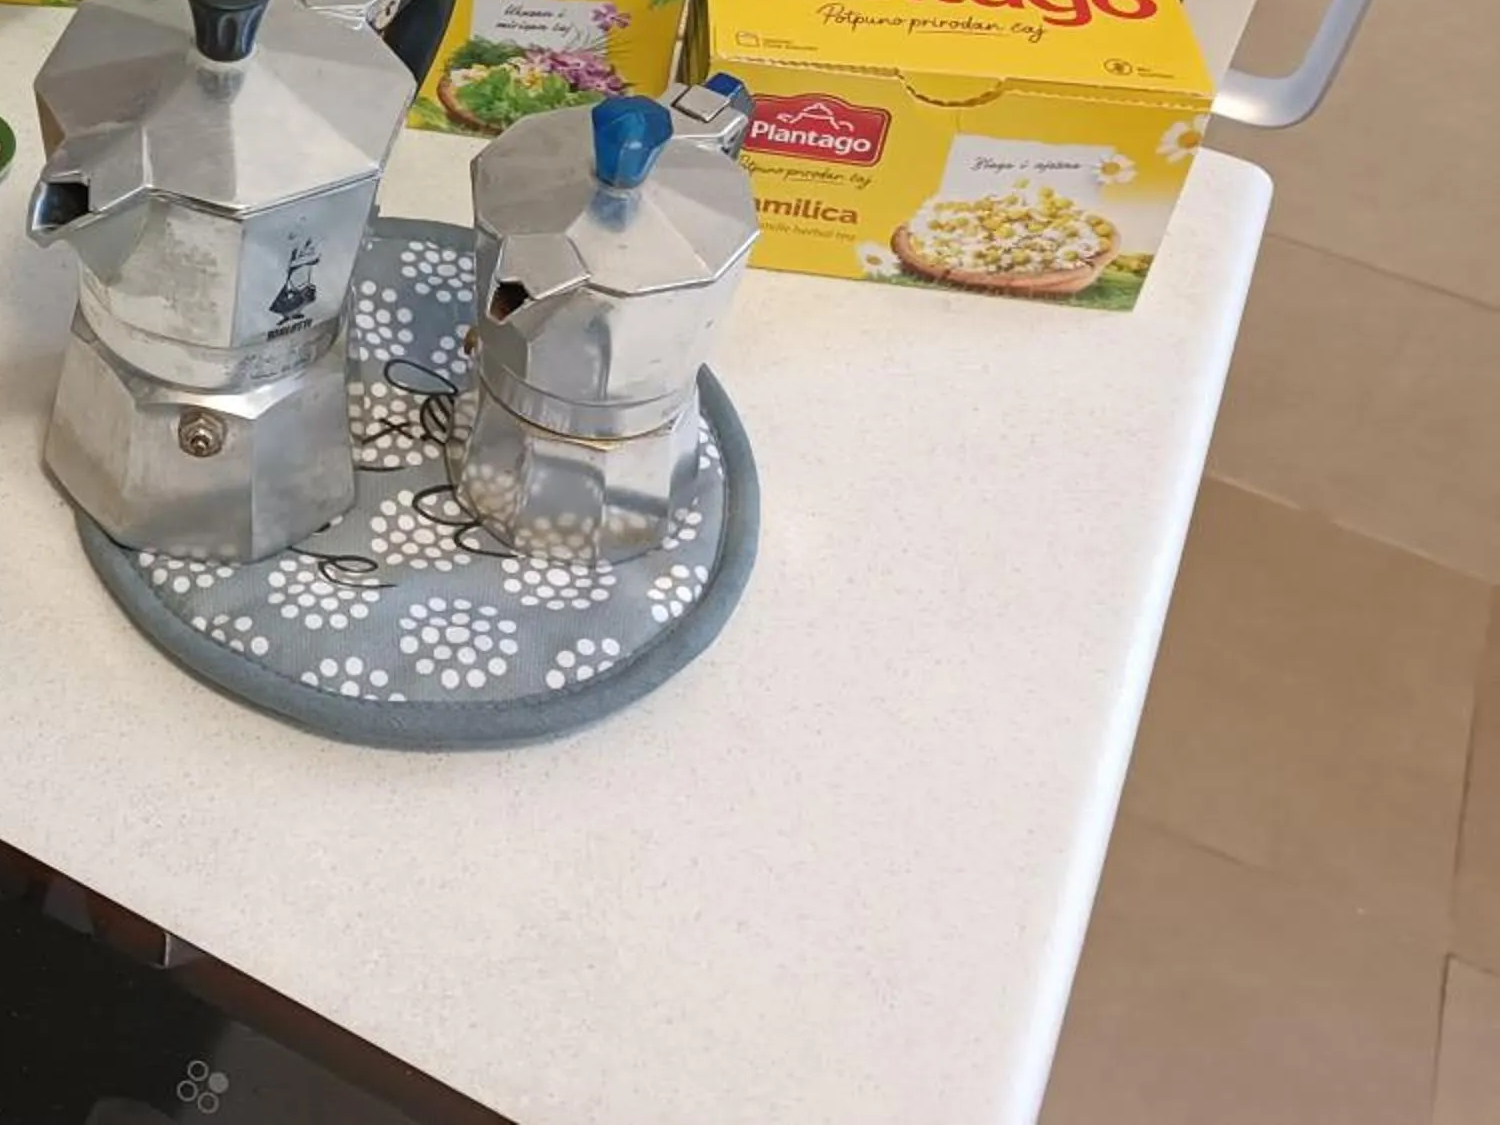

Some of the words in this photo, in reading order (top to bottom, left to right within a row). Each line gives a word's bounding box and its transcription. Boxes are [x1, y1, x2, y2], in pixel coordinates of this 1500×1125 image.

[816, 2, 907, 32] Potpuno
[908, 15, 1003, 35] prirodan
[750, 119, 872, 155] Plantago
